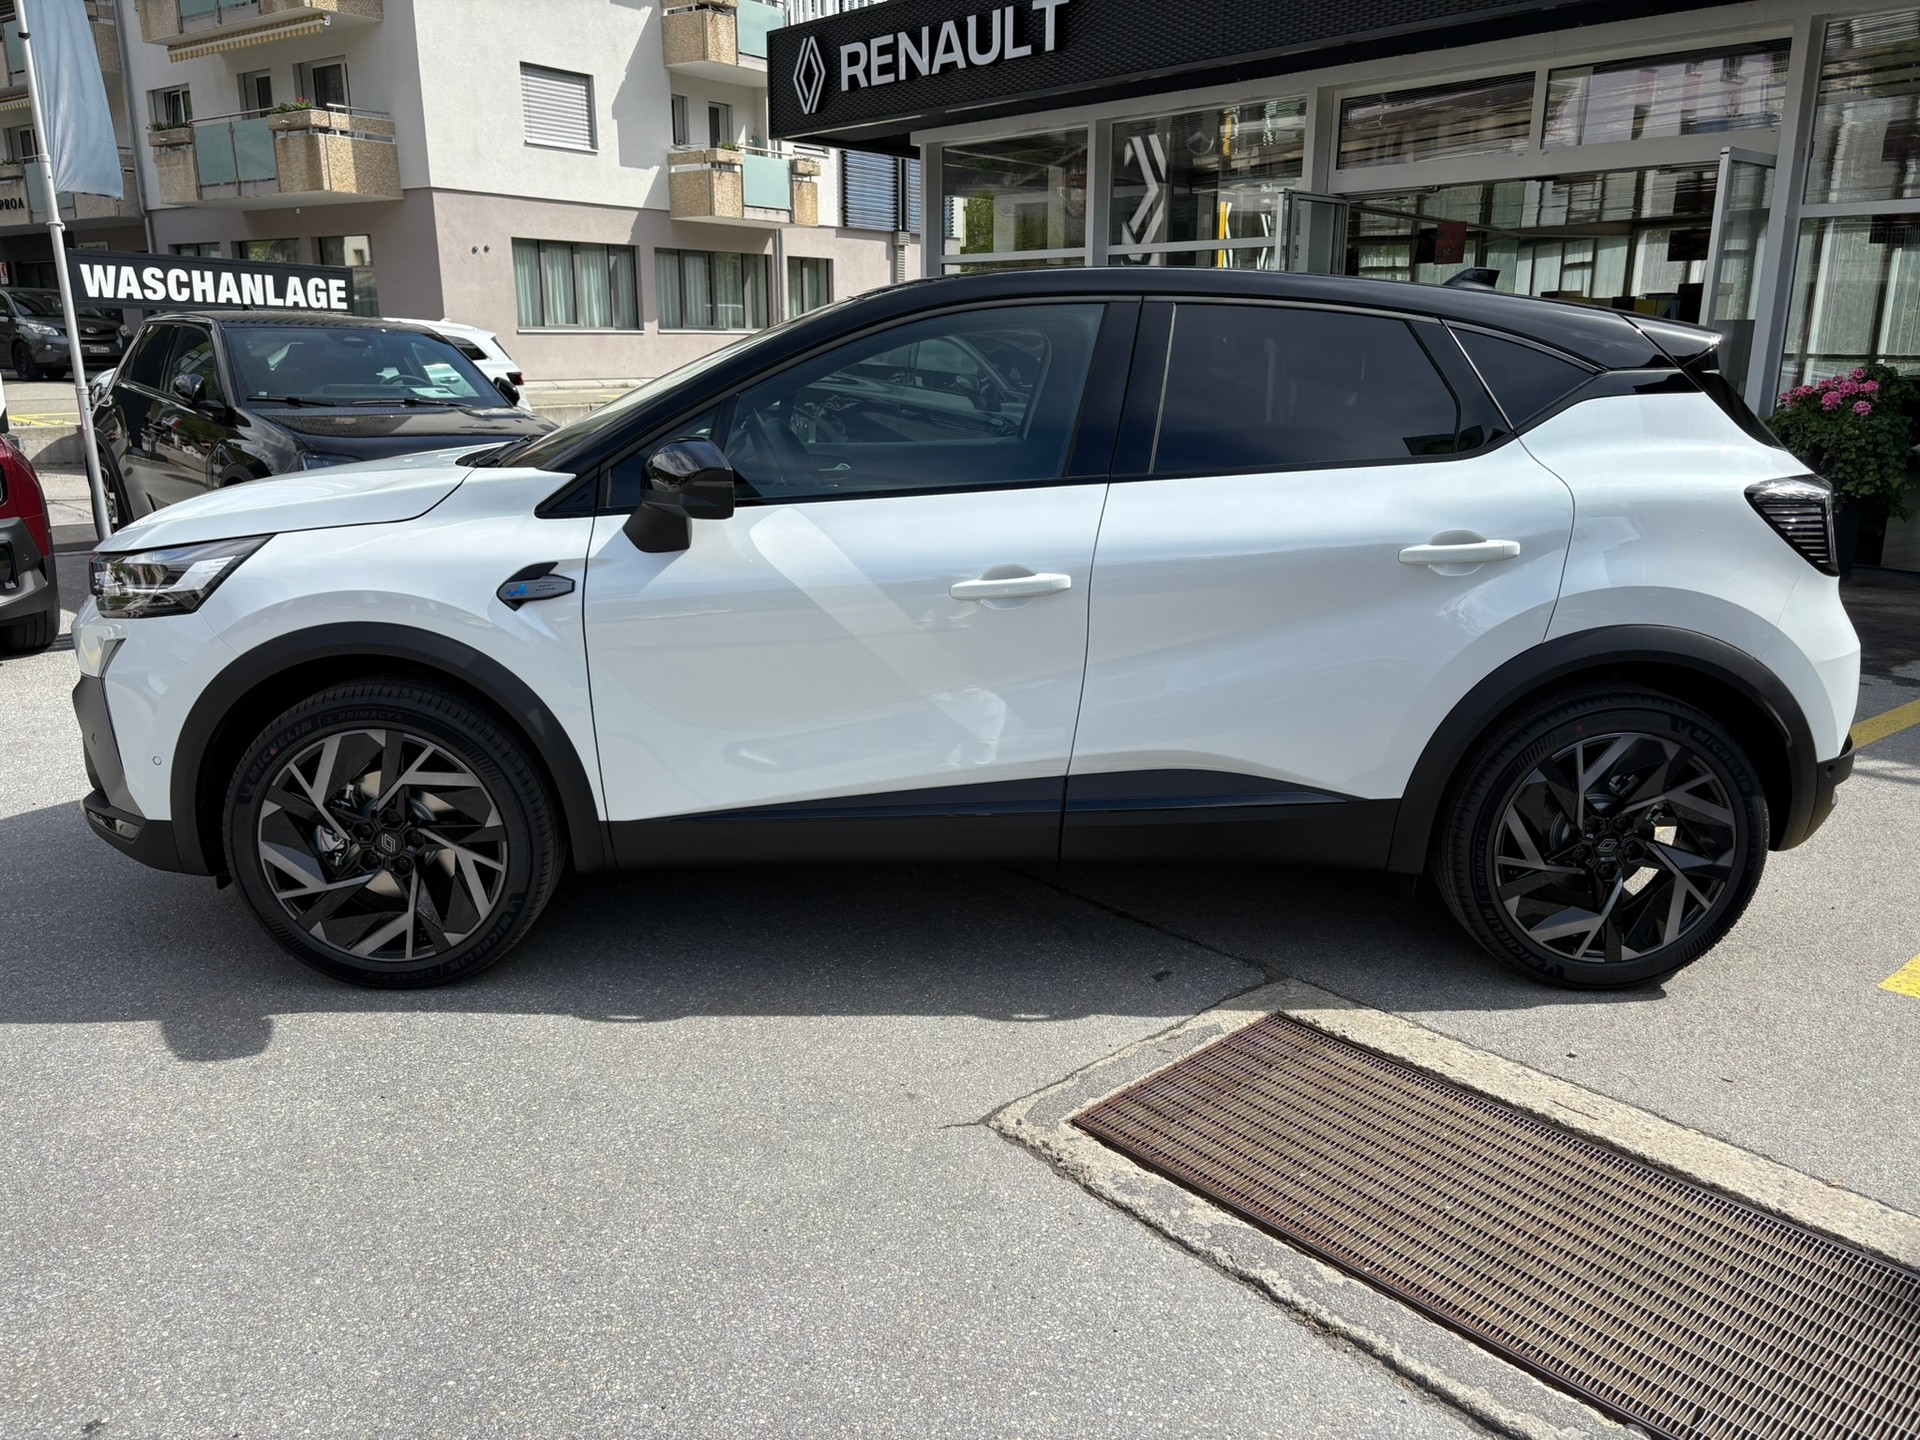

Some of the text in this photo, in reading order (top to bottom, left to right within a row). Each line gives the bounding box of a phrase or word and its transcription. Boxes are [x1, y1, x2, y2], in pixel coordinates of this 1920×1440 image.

[840, 0, 1069, 92] RENAULT
[79, 263, 348, 310] WASCHANLAGE
[1693, 729, 1755, 792] MICHELIN
[449, 912, 517, 973] MICHELIN
[1481, 909, 1546, 978] MICHELIN
